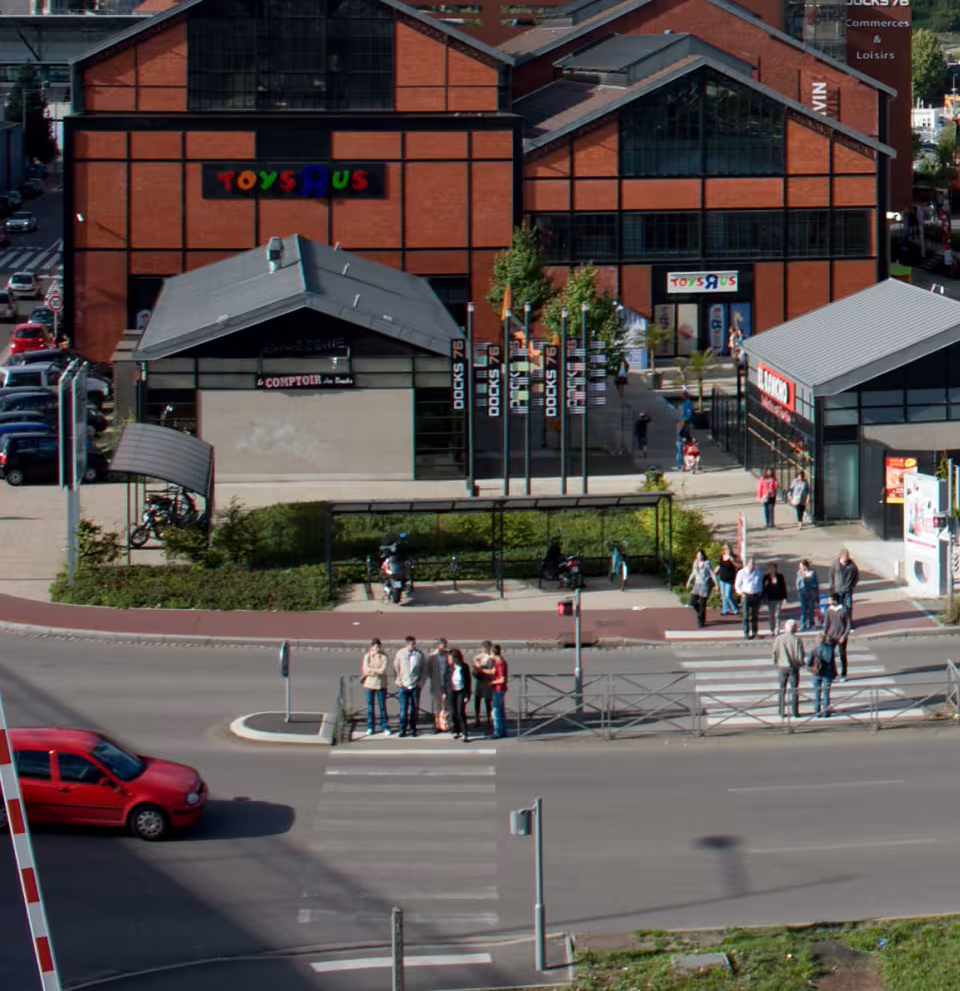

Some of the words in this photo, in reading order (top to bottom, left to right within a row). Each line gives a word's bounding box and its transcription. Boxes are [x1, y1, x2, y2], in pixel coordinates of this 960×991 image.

[845, 19, 910, 27] Commerces
[873, 34, 881, 43] &
[856, 51, 895, 59] Loisirs
[453, 340, 464, 358] 76
[489, 346, 499, 364] 76
[546, 346, 557, 365] 76
[264, 374, 322, 388] COMPTOIR
[453, 362, 464, 409] DOCKS
[488, 368, 499, 416] DOCKS
[546, 369, 557, 416] DOCKS
